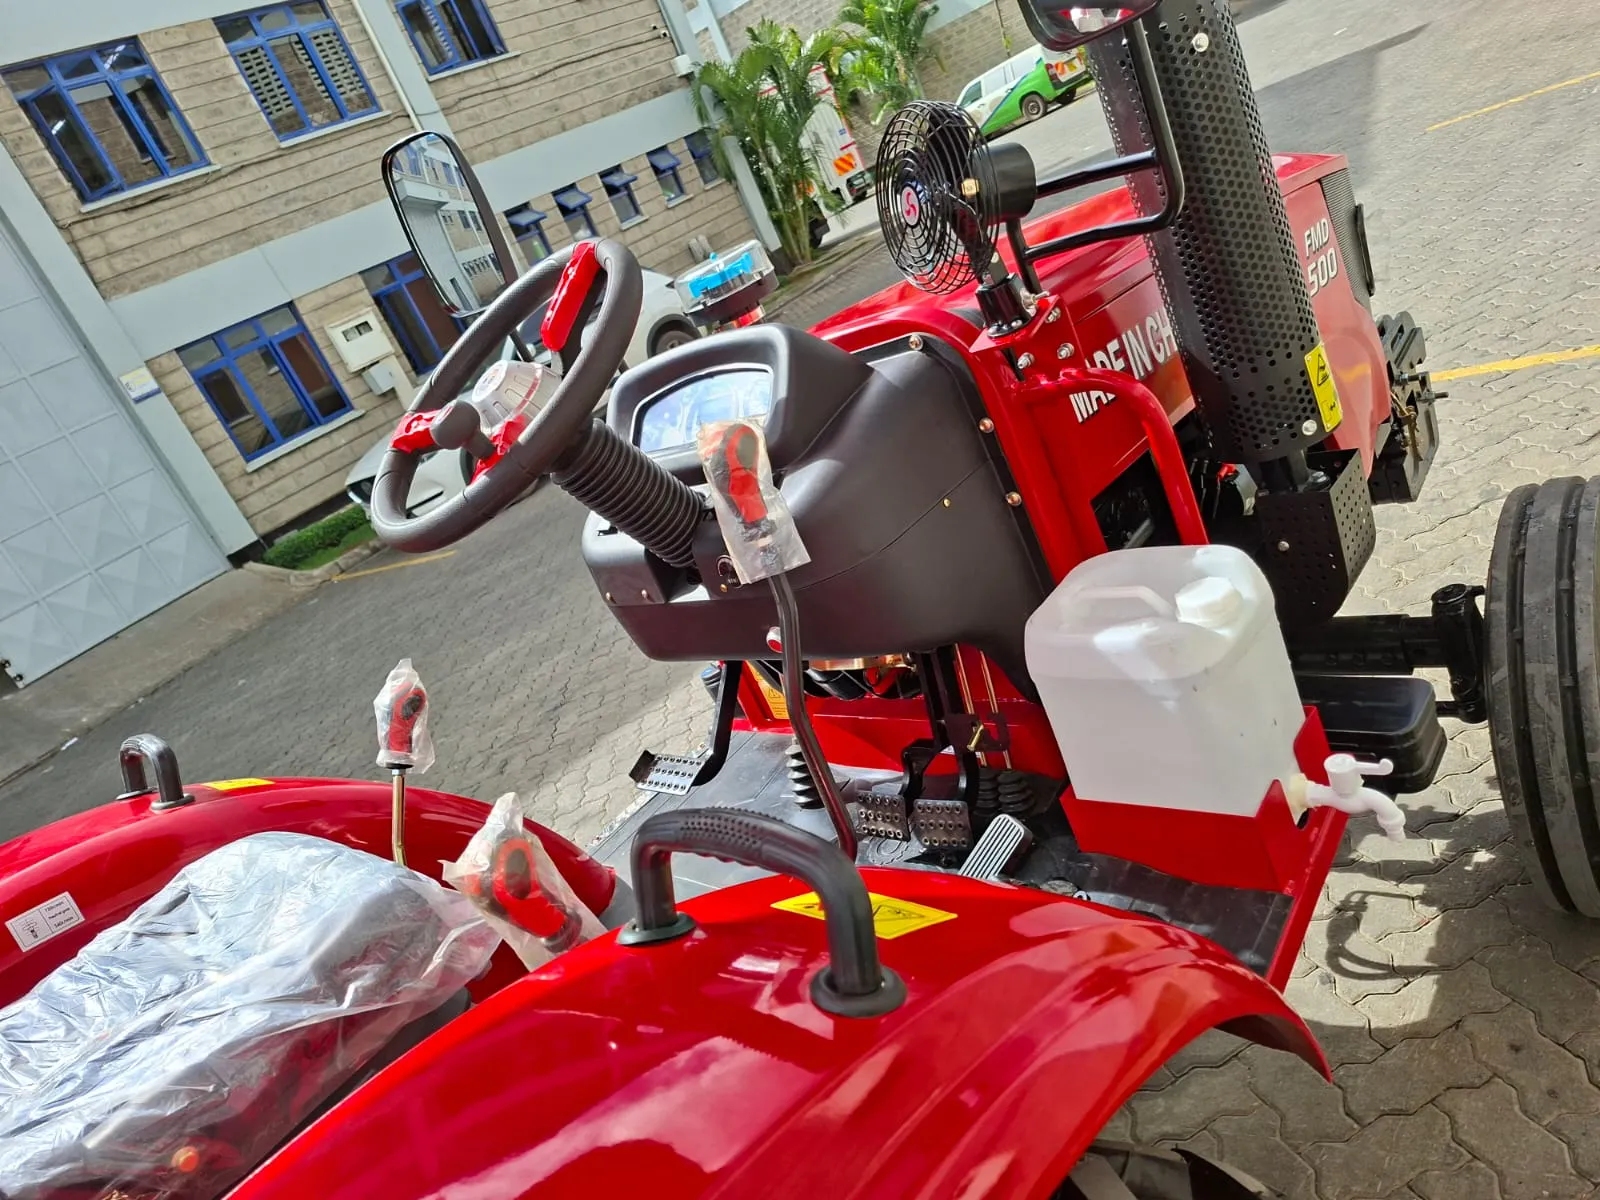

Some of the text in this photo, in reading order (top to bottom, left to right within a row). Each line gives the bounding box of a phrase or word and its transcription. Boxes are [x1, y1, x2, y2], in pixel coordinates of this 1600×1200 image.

[1304, 218, 1329, 258] FMD
[1307, 247, 1338, 297] 500
[1122, 324, 1153, 380] IN
